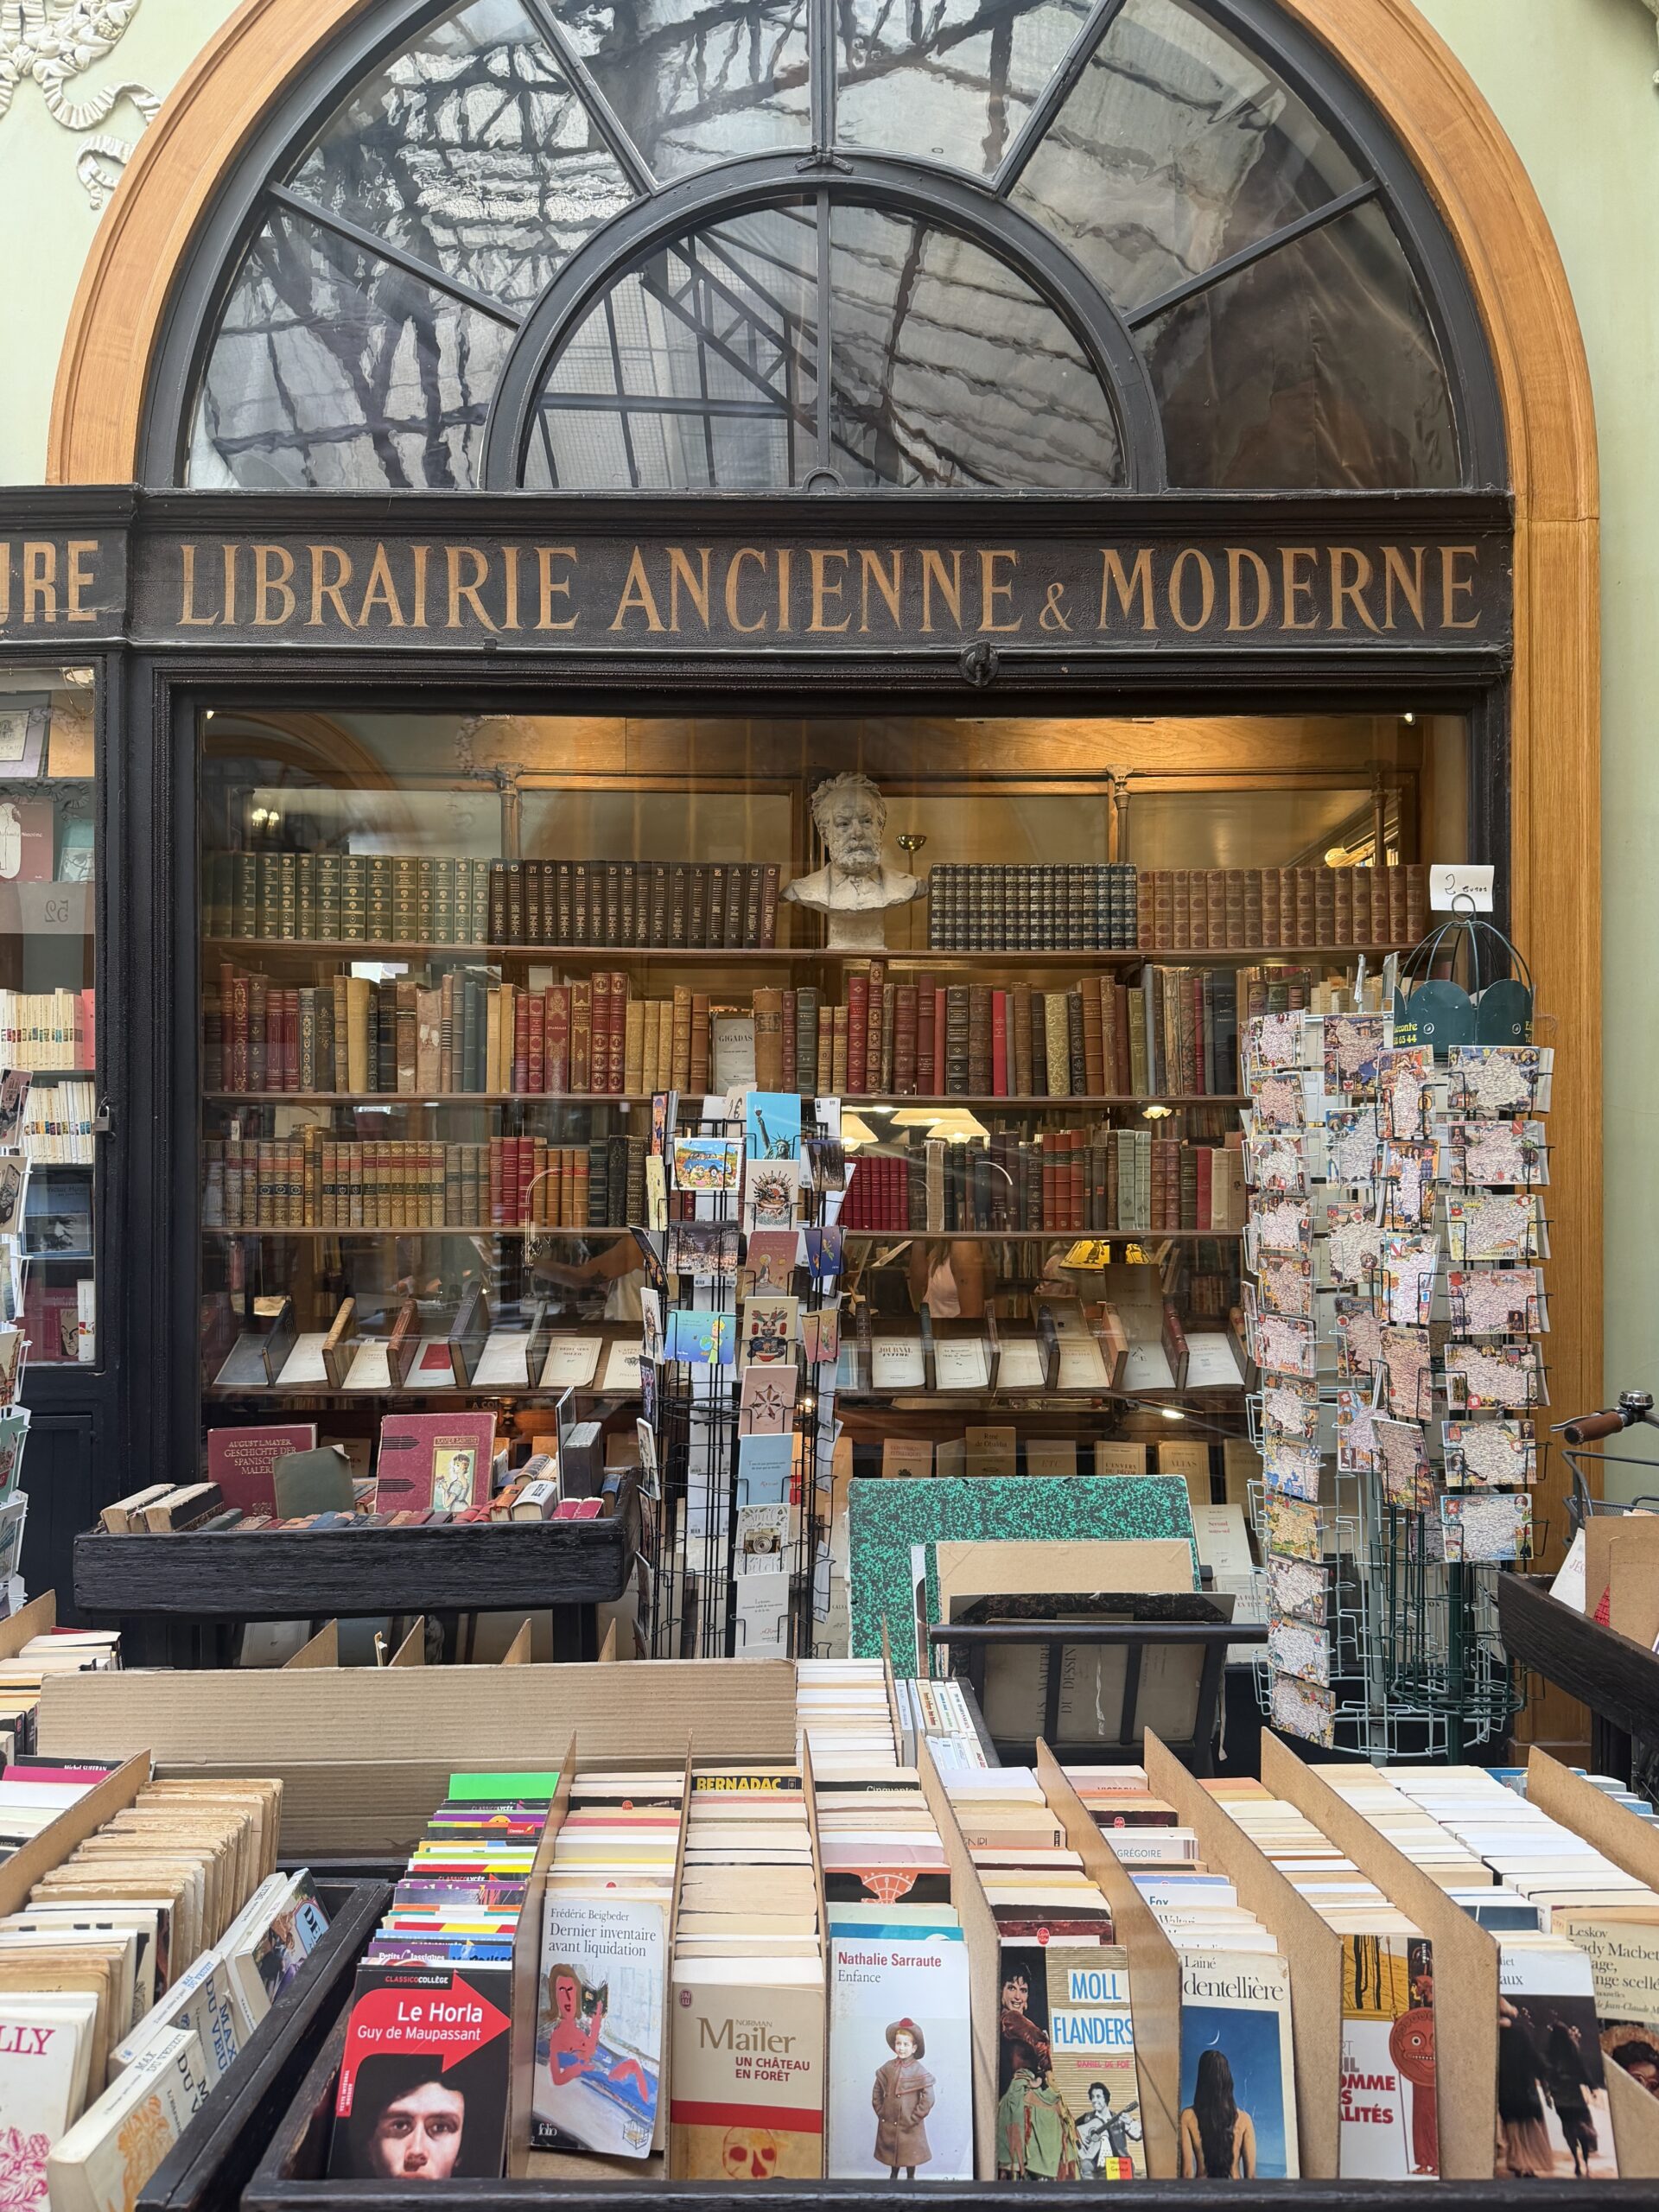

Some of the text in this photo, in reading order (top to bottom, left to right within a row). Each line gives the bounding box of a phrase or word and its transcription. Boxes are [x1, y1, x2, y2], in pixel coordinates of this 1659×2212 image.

[176, 542, 1482, 636] LIBRAIRIE ANCIENNE & MODERNE
[1444, 874, 1457, 895] 2
[718, 1034, 753, 1043] GIGADAS
[224, 1446, 278, 1458] GESCHICHTE
[1062, 1648, 1077, 1690] DESSIN
[696, 1777, 781, 1790] BERNADAC
[1116, 1847, 1162, 1858] GRÉGOIRE
[550, 1908, 630, 1923] Frédéric Beigbeder
[550, 1923, 657, 1942] Dernier inventaire
[1568, 1924, 1608, 1938] Leskov
[549, 1940, 646, 1958] avant liquidation
[1568, 1939, 1605, 1958] ady
[838, 1951, 942, 1967] Nathalie Sarraute
[1185, 1955, 1217, 1969] Lainé
[838, 1969, 881, 1983] Enfance
[1071, 1973, 1122, 2000] MOLL
[1184, 1973, 1284, 2001] dentellière
[397, 2001, 483, 2023] Le Horla
[735, 2018, 773, 2027] NORMAN
[1053, 2016, 1134, 2045] FLANDERS
[357, 2025, 481, 2043] Guy de Maupassant
[696, 2017, 796, 2054] Mailer
[735, 2056, 810, 2071] UN CHÂTEAU
[735, 2069, 791, 2082] EN FORÊT
[538, 2122, 558, 2137] folio
